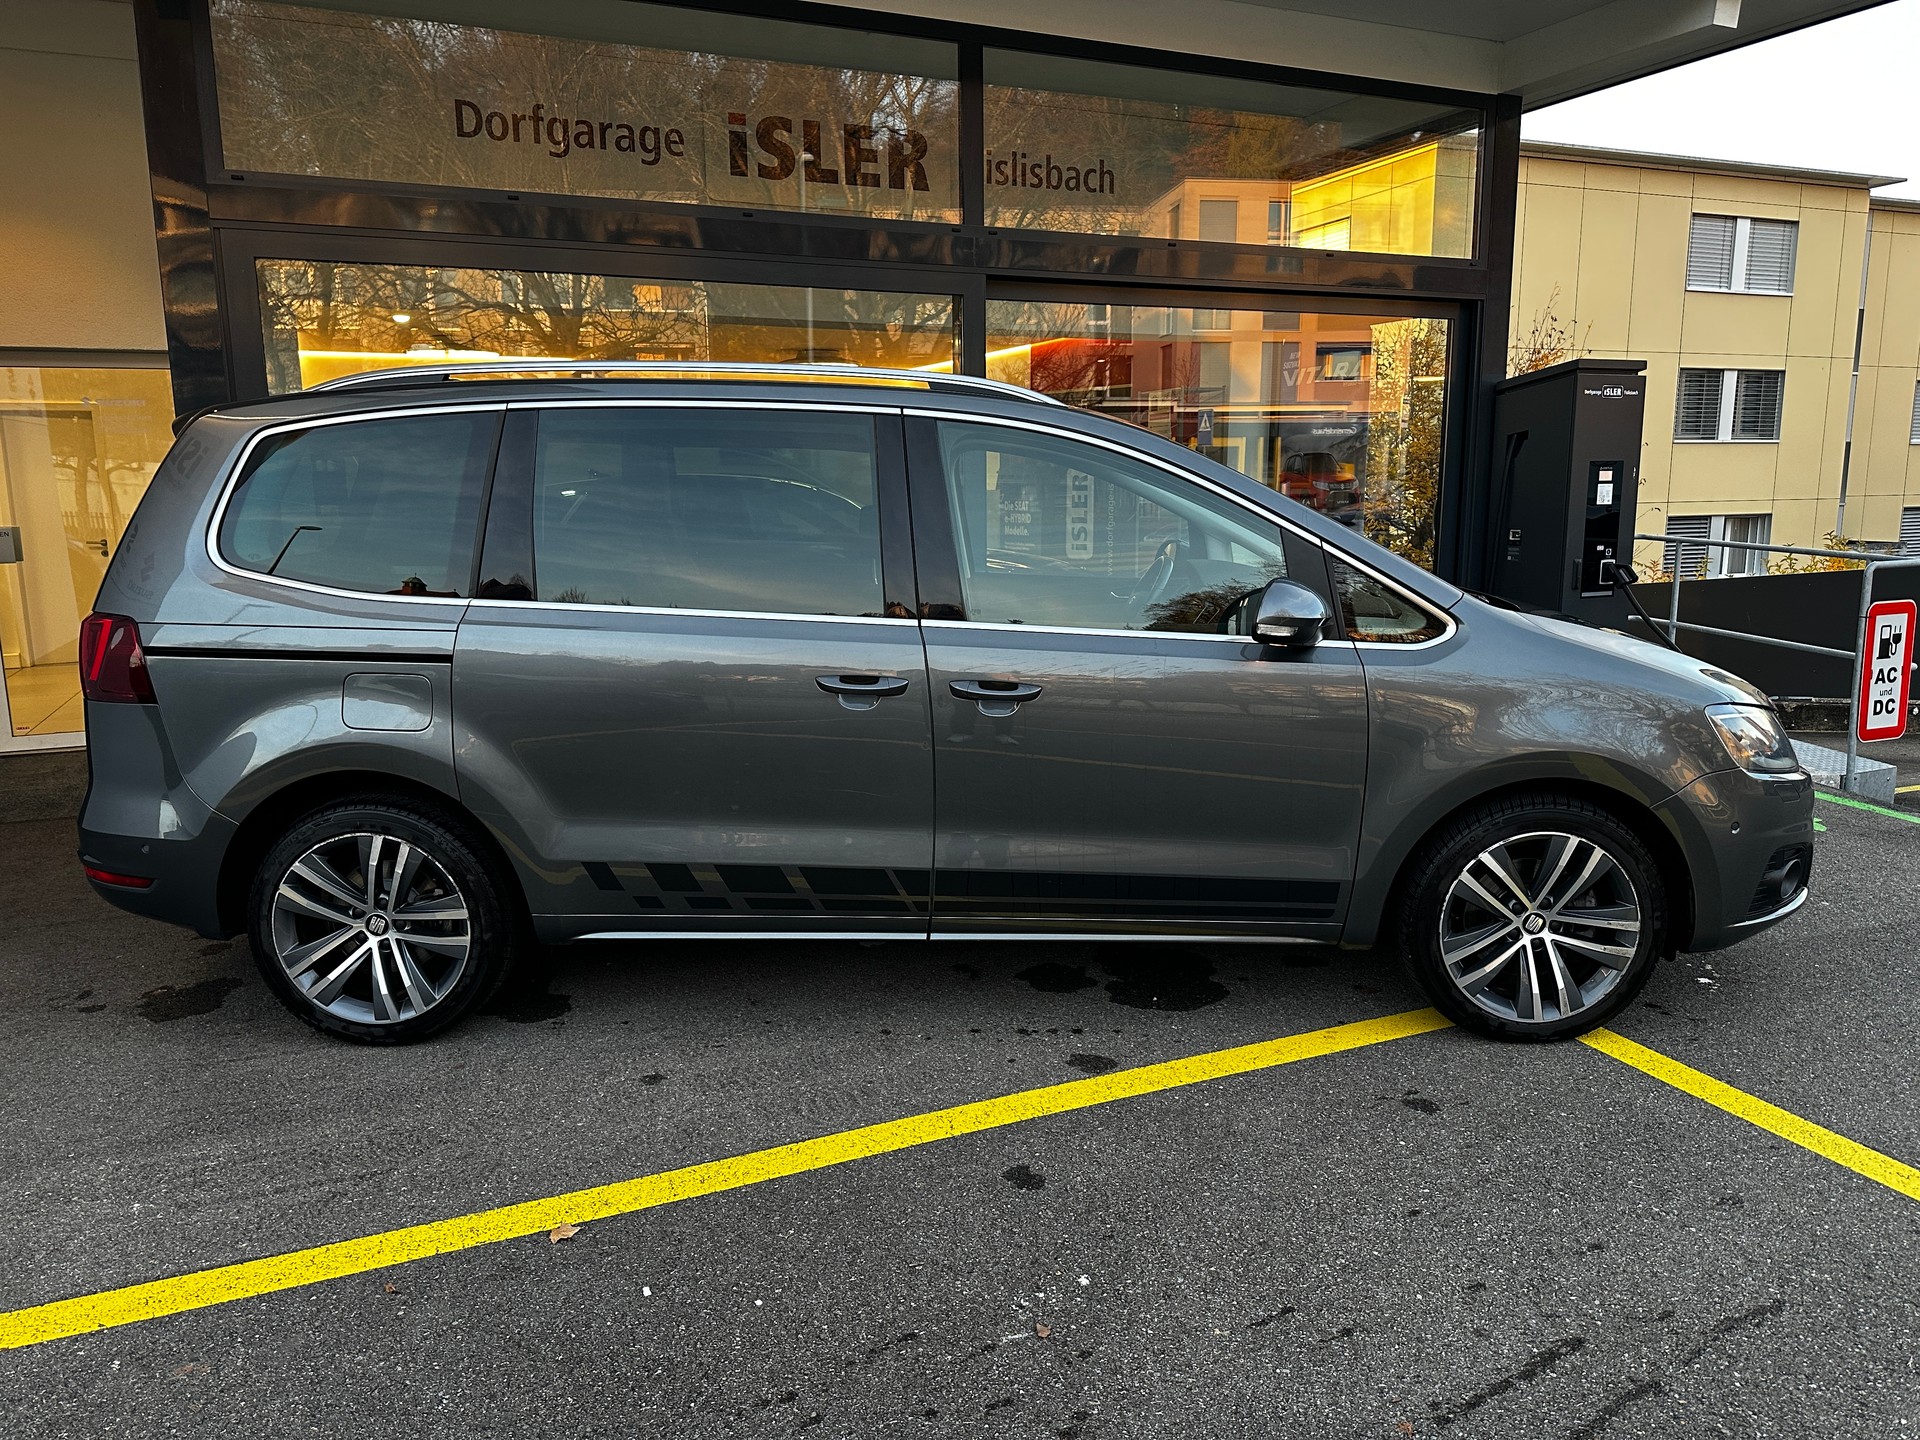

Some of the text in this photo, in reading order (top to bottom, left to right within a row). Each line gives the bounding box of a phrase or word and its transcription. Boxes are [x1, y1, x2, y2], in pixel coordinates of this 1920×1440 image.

[454, 98, 1115, 194] Dorfgarage iSLER islisbach
[1015, 500, 1029, 511] SEAT
[1071, 474, 1089, 551] iSLER
[1874, 667, 1898, 684] AC
[1880, 687, 1893, 696] und
[1873, 698, 1896, 715] DC
